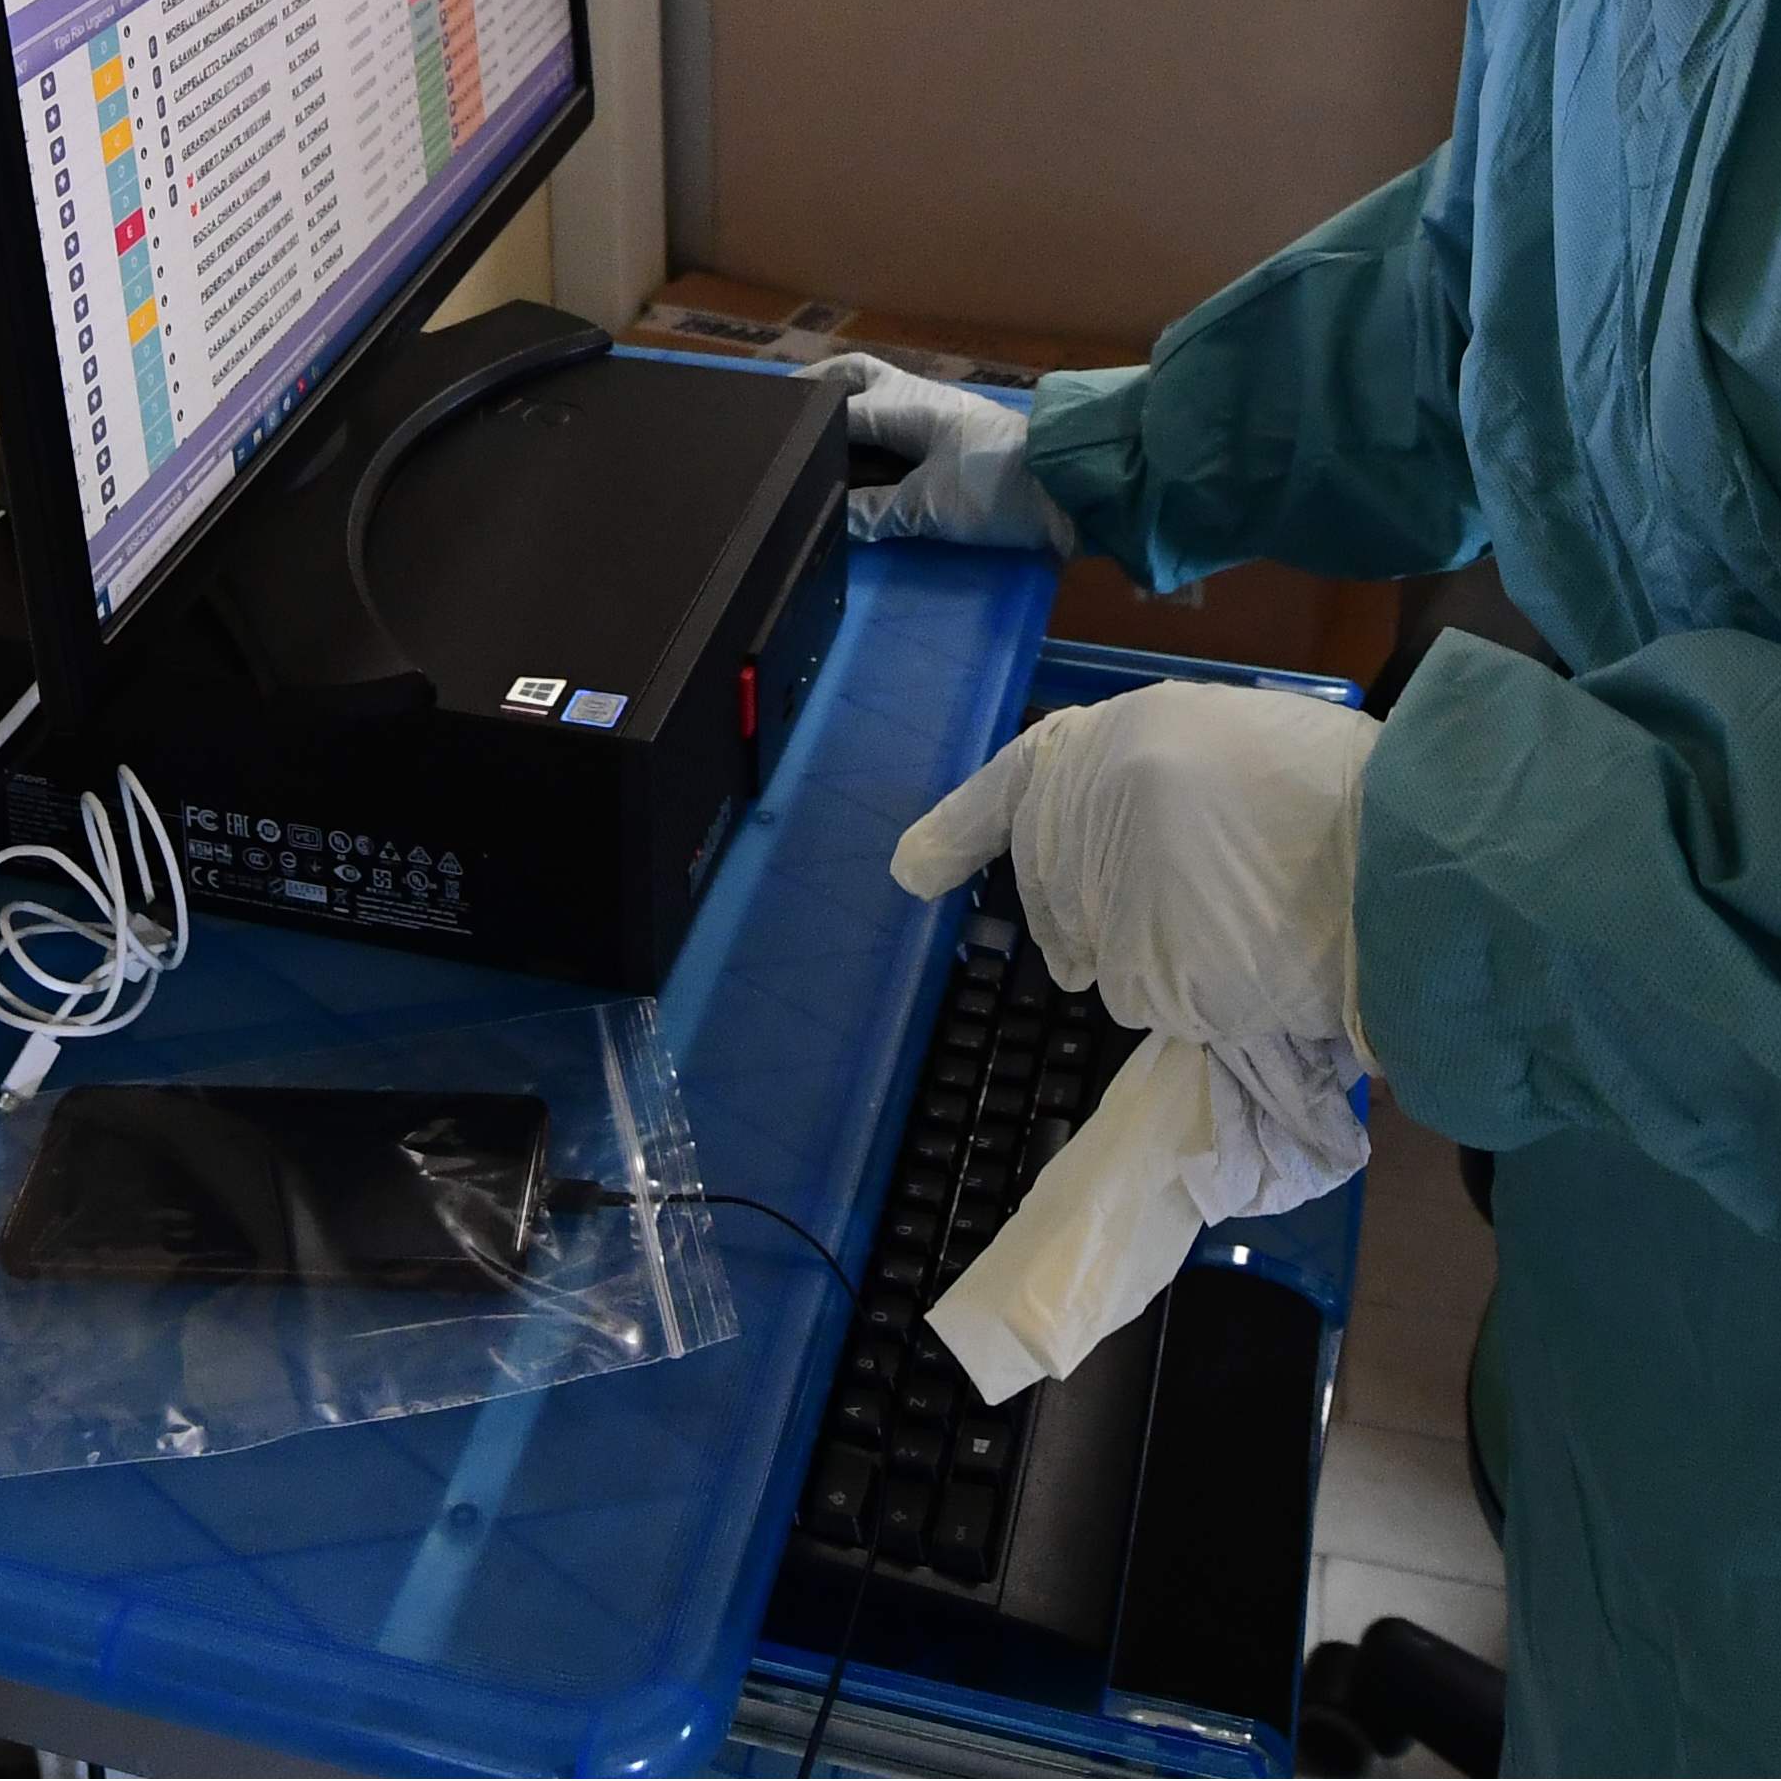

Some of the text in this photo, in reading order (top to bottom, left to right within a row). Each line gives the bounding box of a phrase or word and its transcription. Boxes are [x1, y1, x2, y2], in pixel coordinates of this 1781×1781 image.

[85, 0, 115, 35] Urgenza
[165, 13, 194, 45] MORELLI
[294, 12, 316, 41] TORACE
[297, 39, 319, 68] TORACE
[173, 58, 219, 105] CAPPELLETTO
[300, 65, 322, 95] TORACE
[303, 91, 325, 121] TORACE
